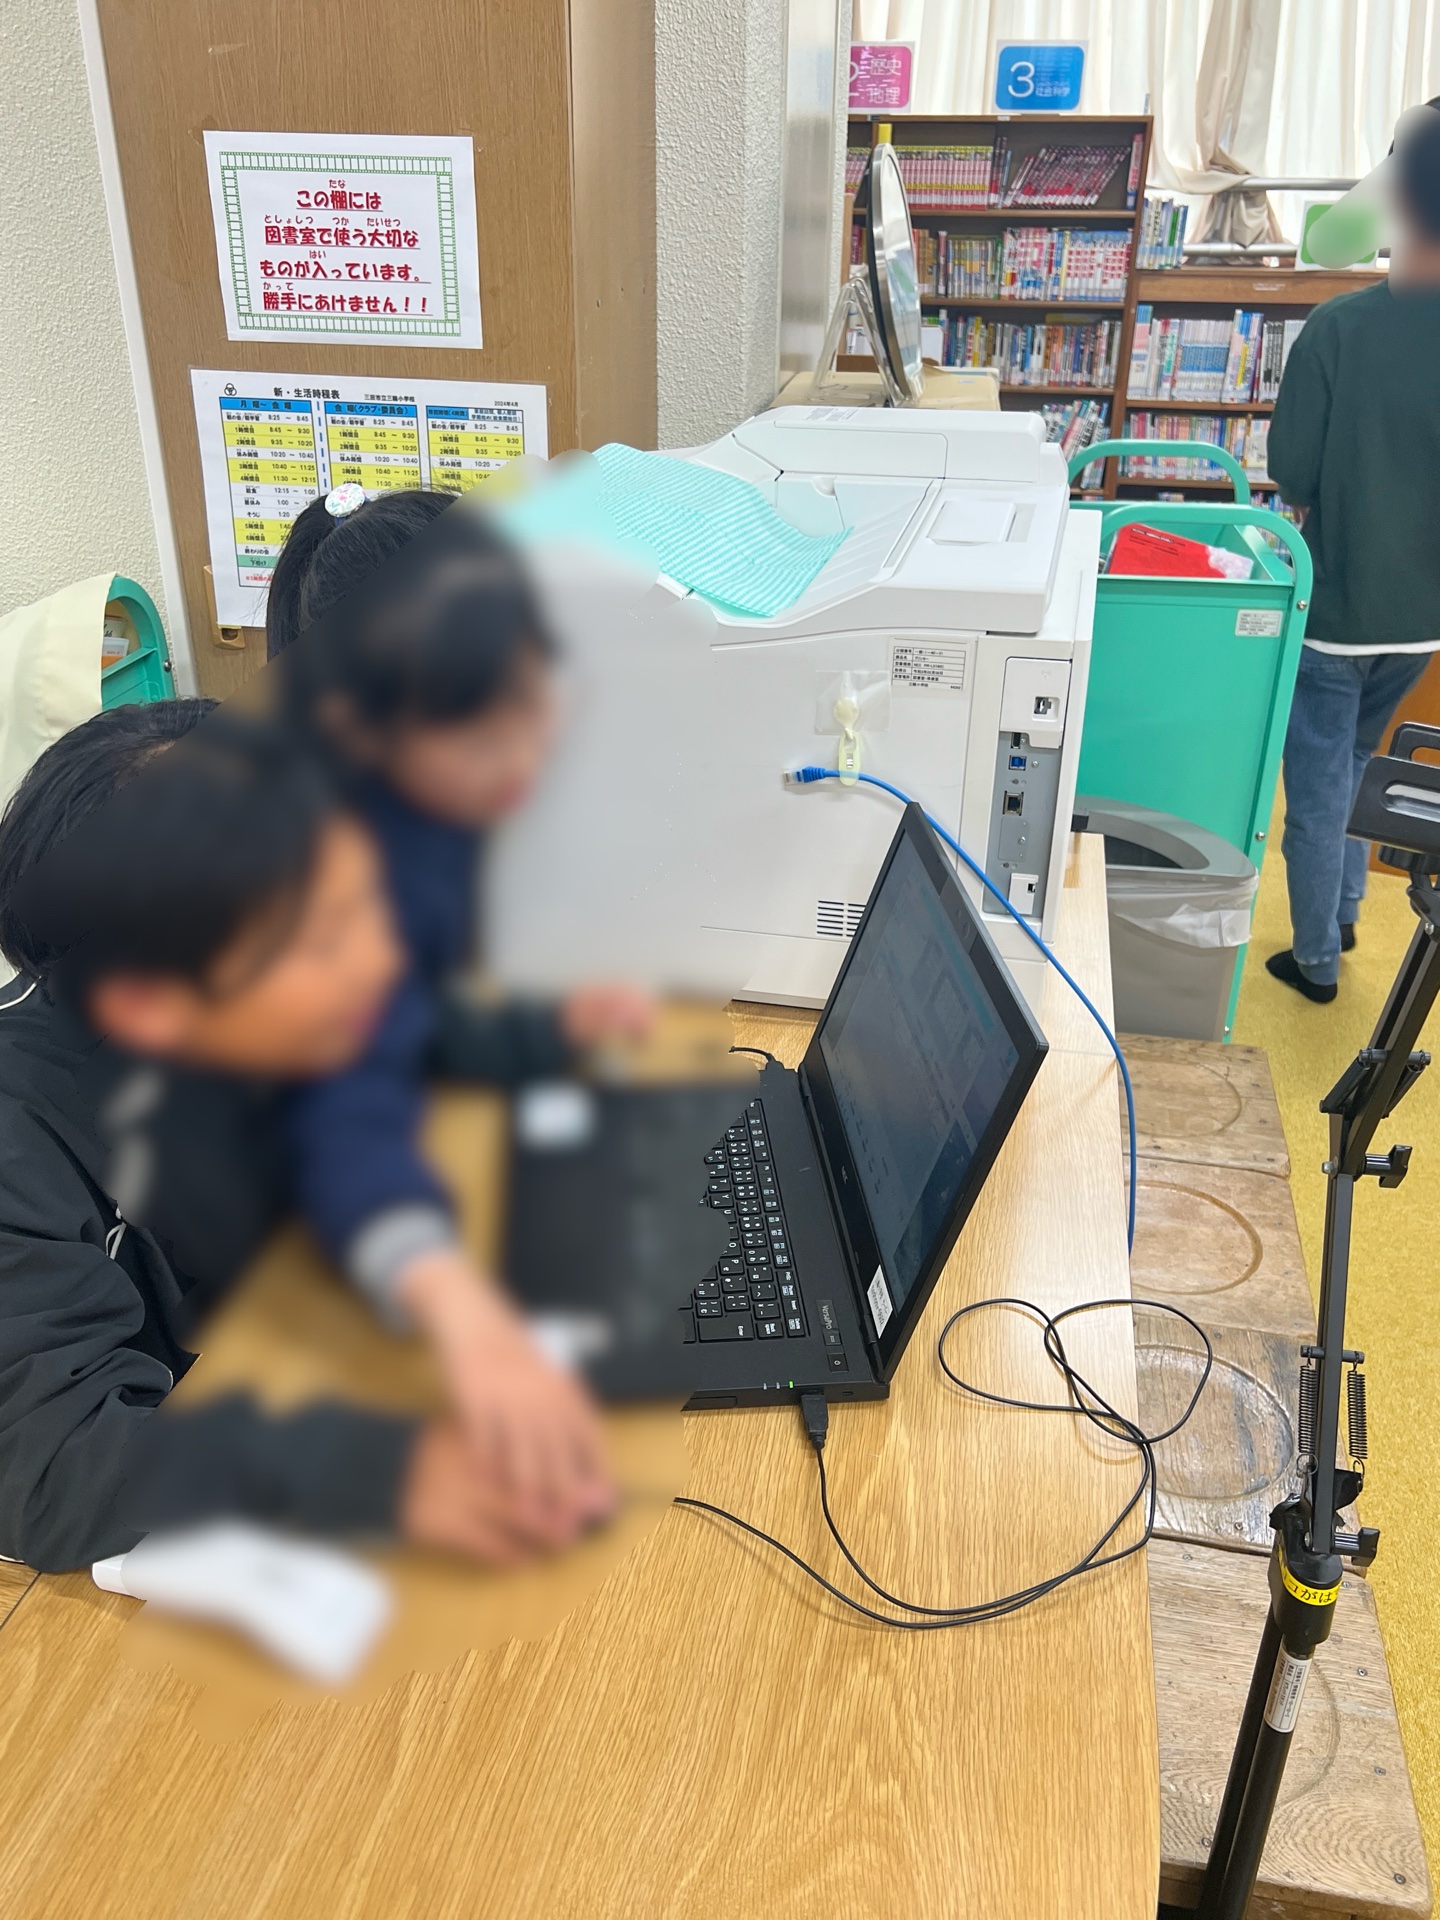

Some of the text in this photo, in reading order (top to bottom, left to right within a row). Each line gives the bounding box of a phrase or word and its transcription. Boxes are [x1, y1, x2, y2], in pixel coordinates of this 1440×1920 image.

[1008, 61, 1035, 98] 3
[328, 179, 346, 189] たな
[296, 190, 382, 210] この棚には
[264, 214, 401, 227] としょしつ つか たいせつ
[264, 225, 420, 248] 図書室で使う大切な
[309, 250, 327, 259] はい
[260, 260, 420, 282] ものが入っています。
[263, 282, 294, 291] かって
[262, 292, 427, 313] 勝手にあけません！！
[274, 387, 340, 400] 新・生活時程表
[822, 1304, 832, 1330] VersaPro
